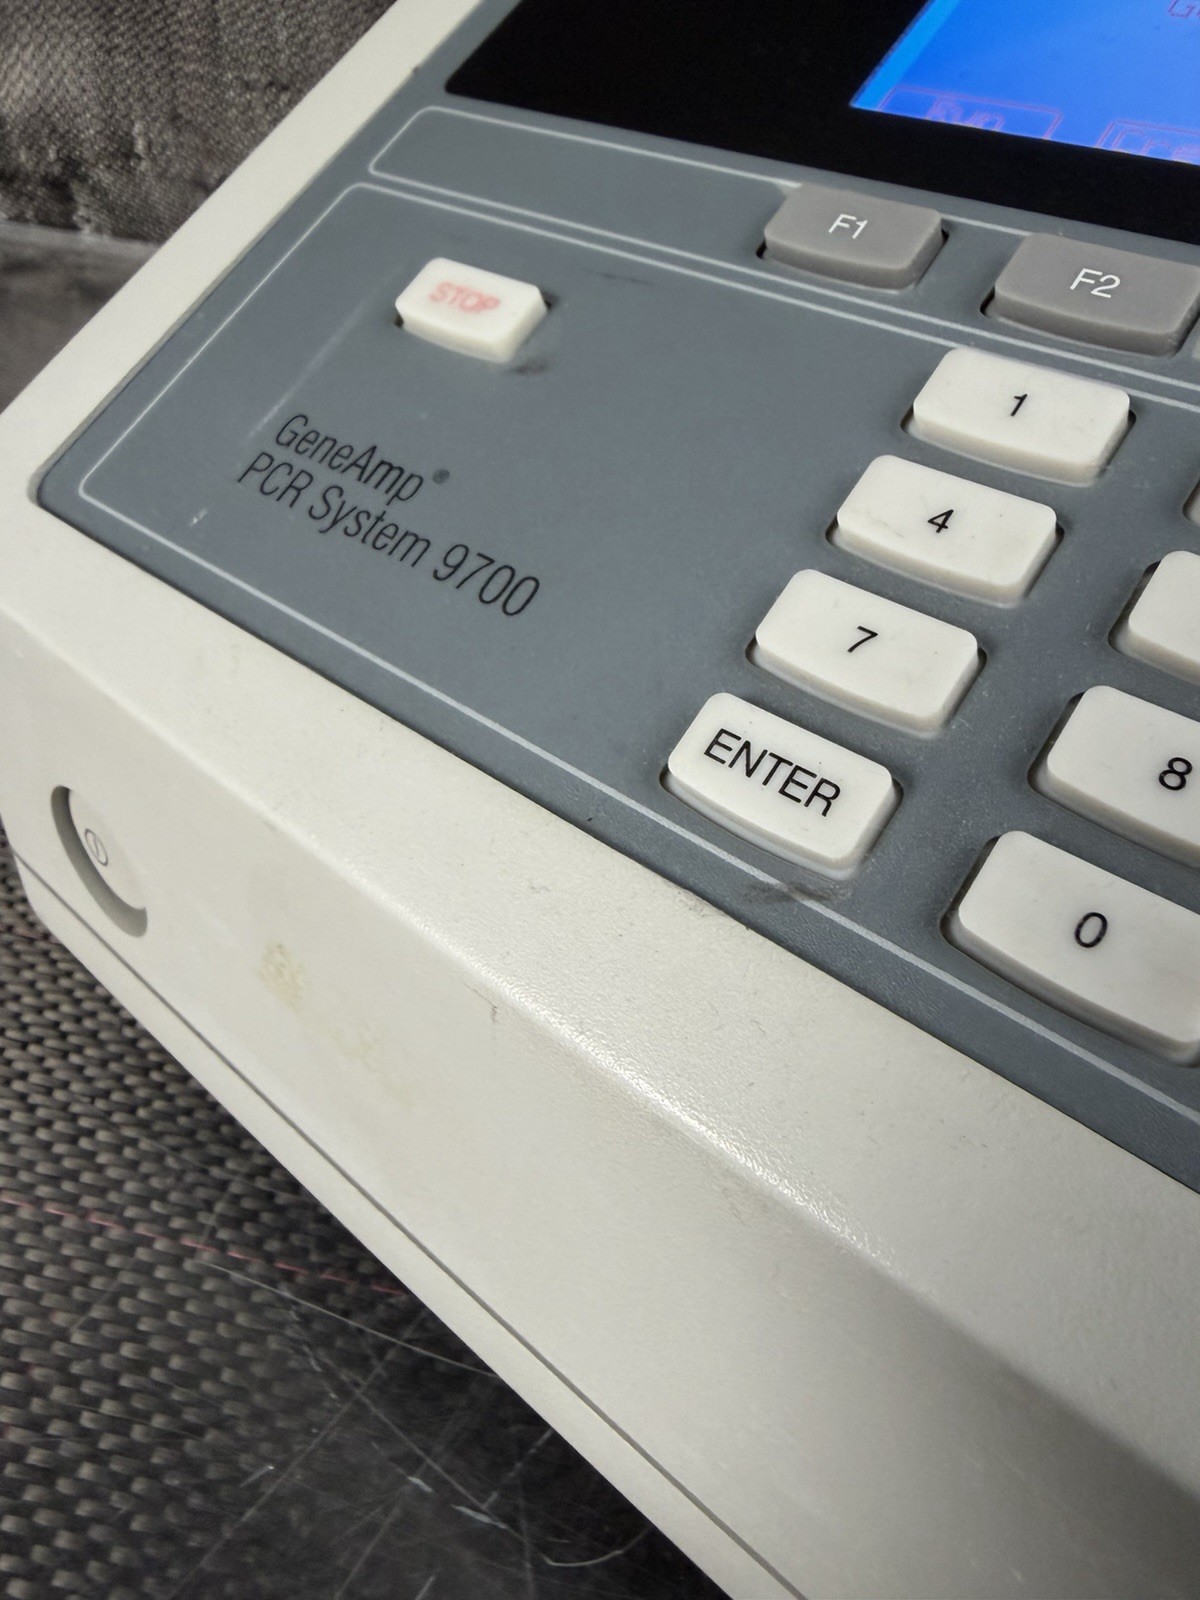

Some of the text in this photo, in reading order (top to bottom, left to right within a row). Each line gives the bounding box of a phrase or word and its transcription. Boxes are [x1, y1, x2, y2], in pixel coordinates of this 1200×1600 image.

[828, 213, 868, 239] F1
[428, 280, 500, 313] STOP
[1069, 267, 1121, 298] F2
[1010, 393, 1028, 417] 1
[274, 413, 425, 506] GeneAmp
[237, 451, 541, 617] PCR System 9700
[926, 508, 954, 534] 4
[847, 626, 878, 653] 7
[703, 728, 841, 818] ENTER
[1158, 757, 1193, 791] 8
[1074, 911, 1108, 949] 0
